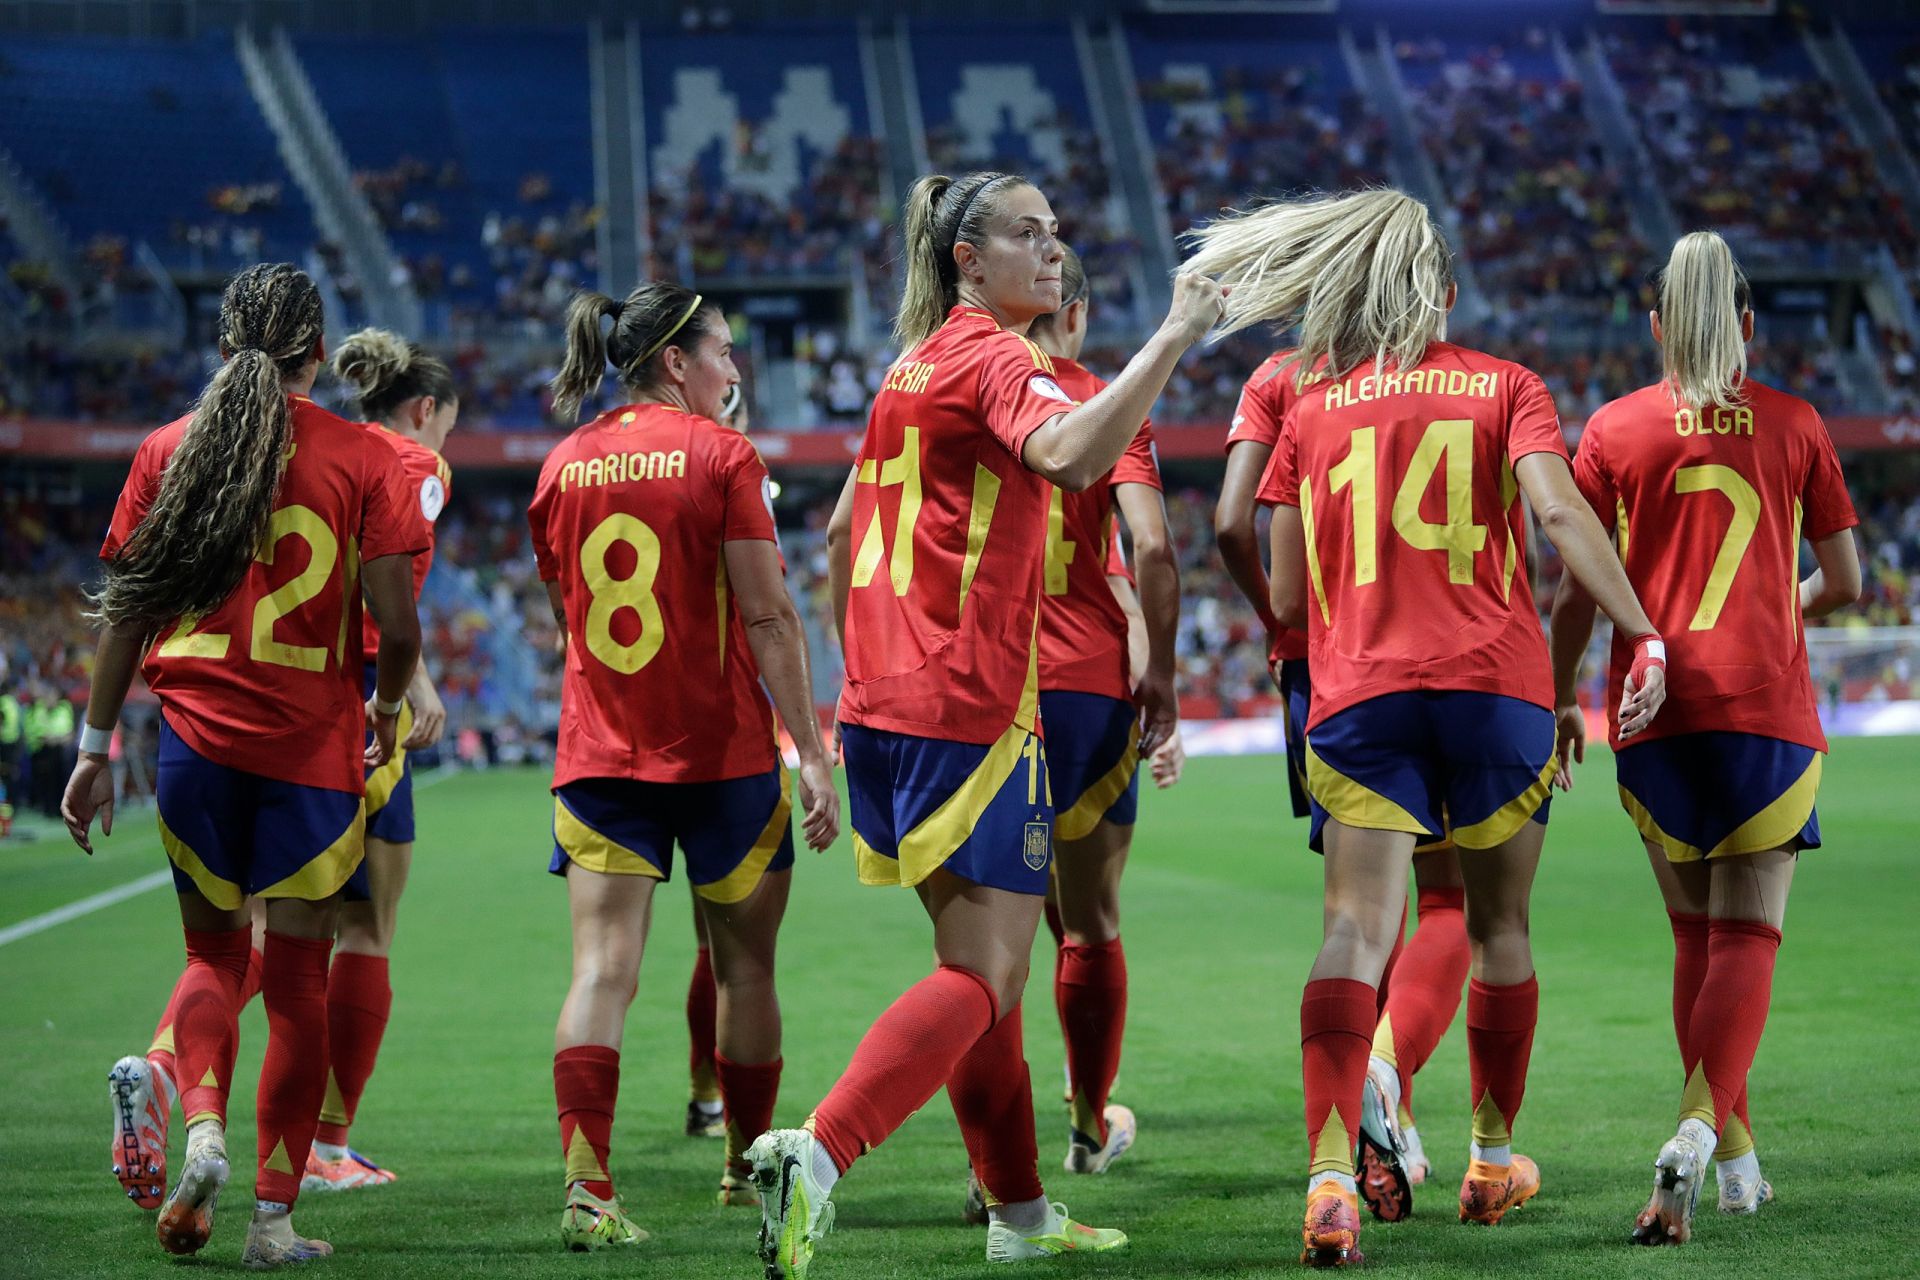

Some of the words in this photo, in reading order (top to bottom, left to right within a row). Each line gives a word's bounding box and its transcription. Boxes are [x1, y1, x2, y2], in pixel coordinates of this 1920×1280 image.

[883, 361, 935, 394] EXIA
[1325, 369, 1498, 411] ALEIXANDRI
[1675, 407, 1754, 437] OLGA
[560, 450, 686, 493] MARIONA
[1328, 420, 1488, 587] 14
[1675, 464, 1761, 631] 7
[580, 512, 665, 675] 8
